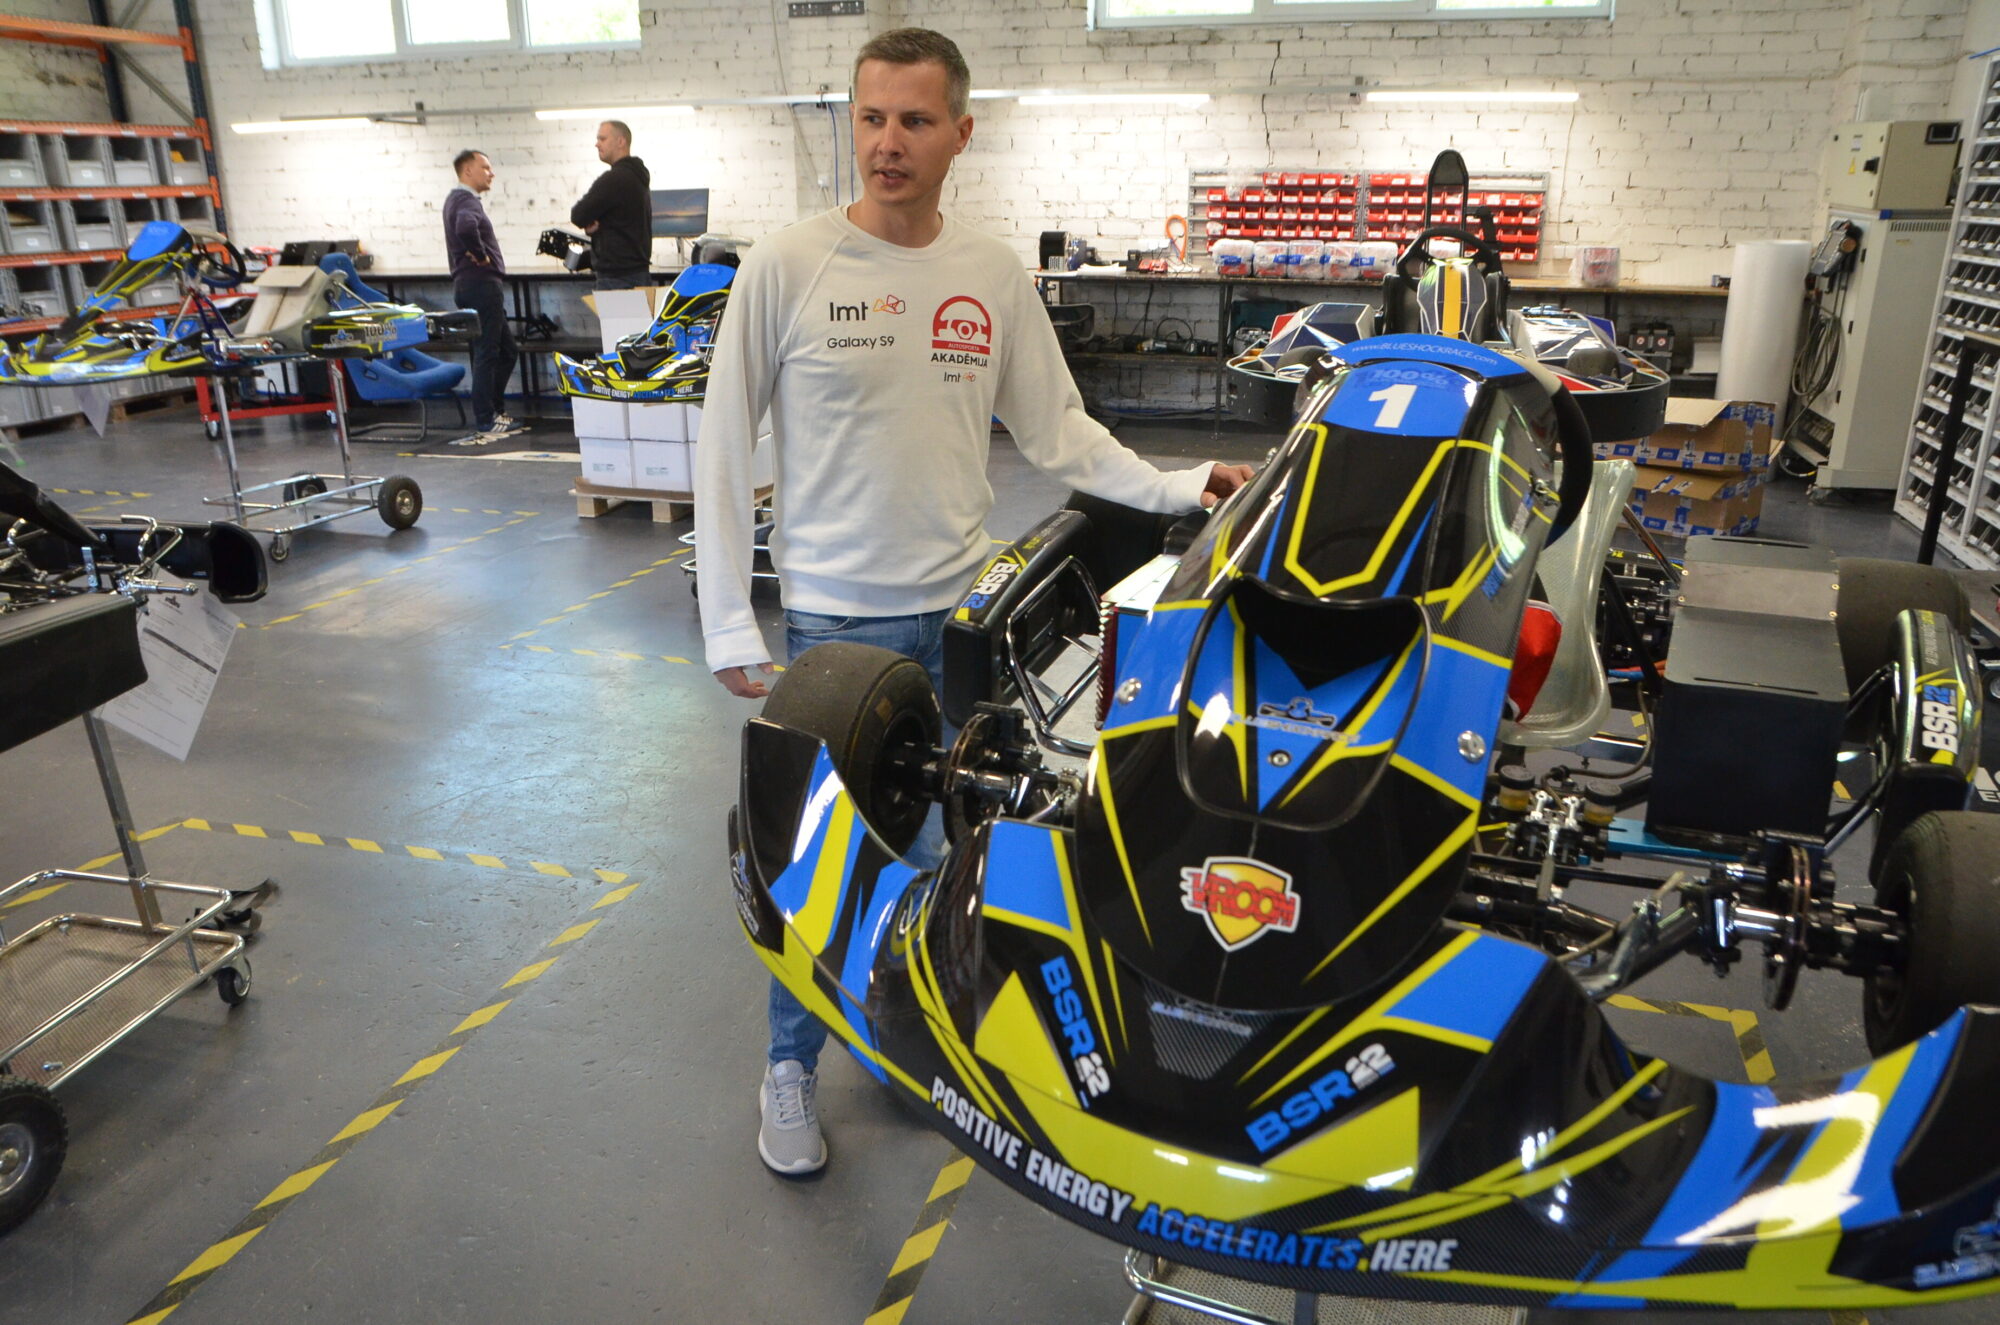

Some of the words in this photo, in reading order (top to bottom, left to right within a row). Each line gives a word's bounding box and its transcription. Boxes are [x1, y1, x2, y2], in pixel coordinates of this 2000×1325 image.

[826, 336, 877, 350] Galaxy
[879, 335, 895, 347] S9
[930, 352, 988, 368] AKADĒMIJA
[1368, 383, 1418, 429] 1
[1190, 872, 1297, 928] VROOM
[931, 1075, 1023, 1170] POSITIVE
[1024, 1148, 1133, 1224] ENERGY
